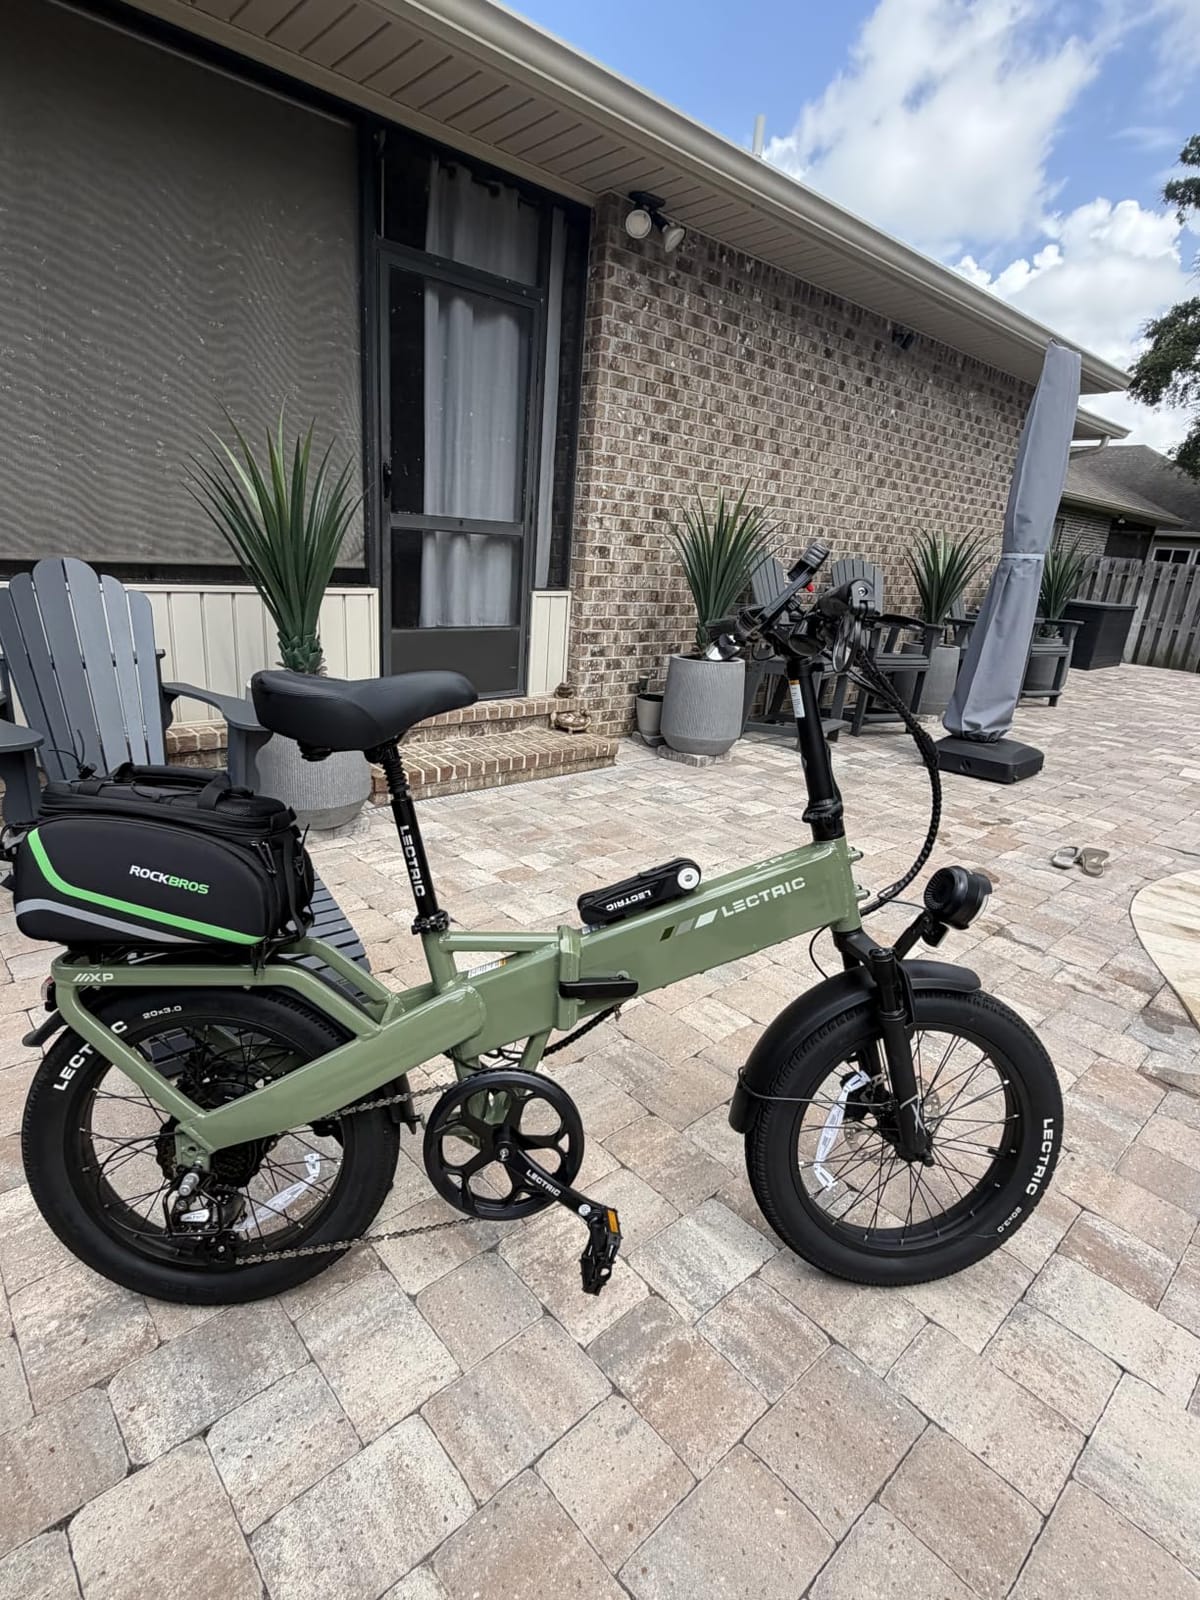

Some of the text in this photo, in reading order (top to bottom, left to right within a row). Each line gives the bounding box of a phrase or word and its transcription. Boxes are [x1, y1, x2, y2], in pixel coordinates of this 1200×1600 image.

[129, 865, 210, 895] ROCKBROS
[399, 824, 426, 897] LECTRIC
[606, 889, 652, 911] LECTRIC
[721, 877, 806, 917] LECTRIC
[53, 1021, 128, 1091] LECTC
[1025, 1118, 1054, 1196] LECTRIC
[526, 1169, 561, 1197] LECTRIC
